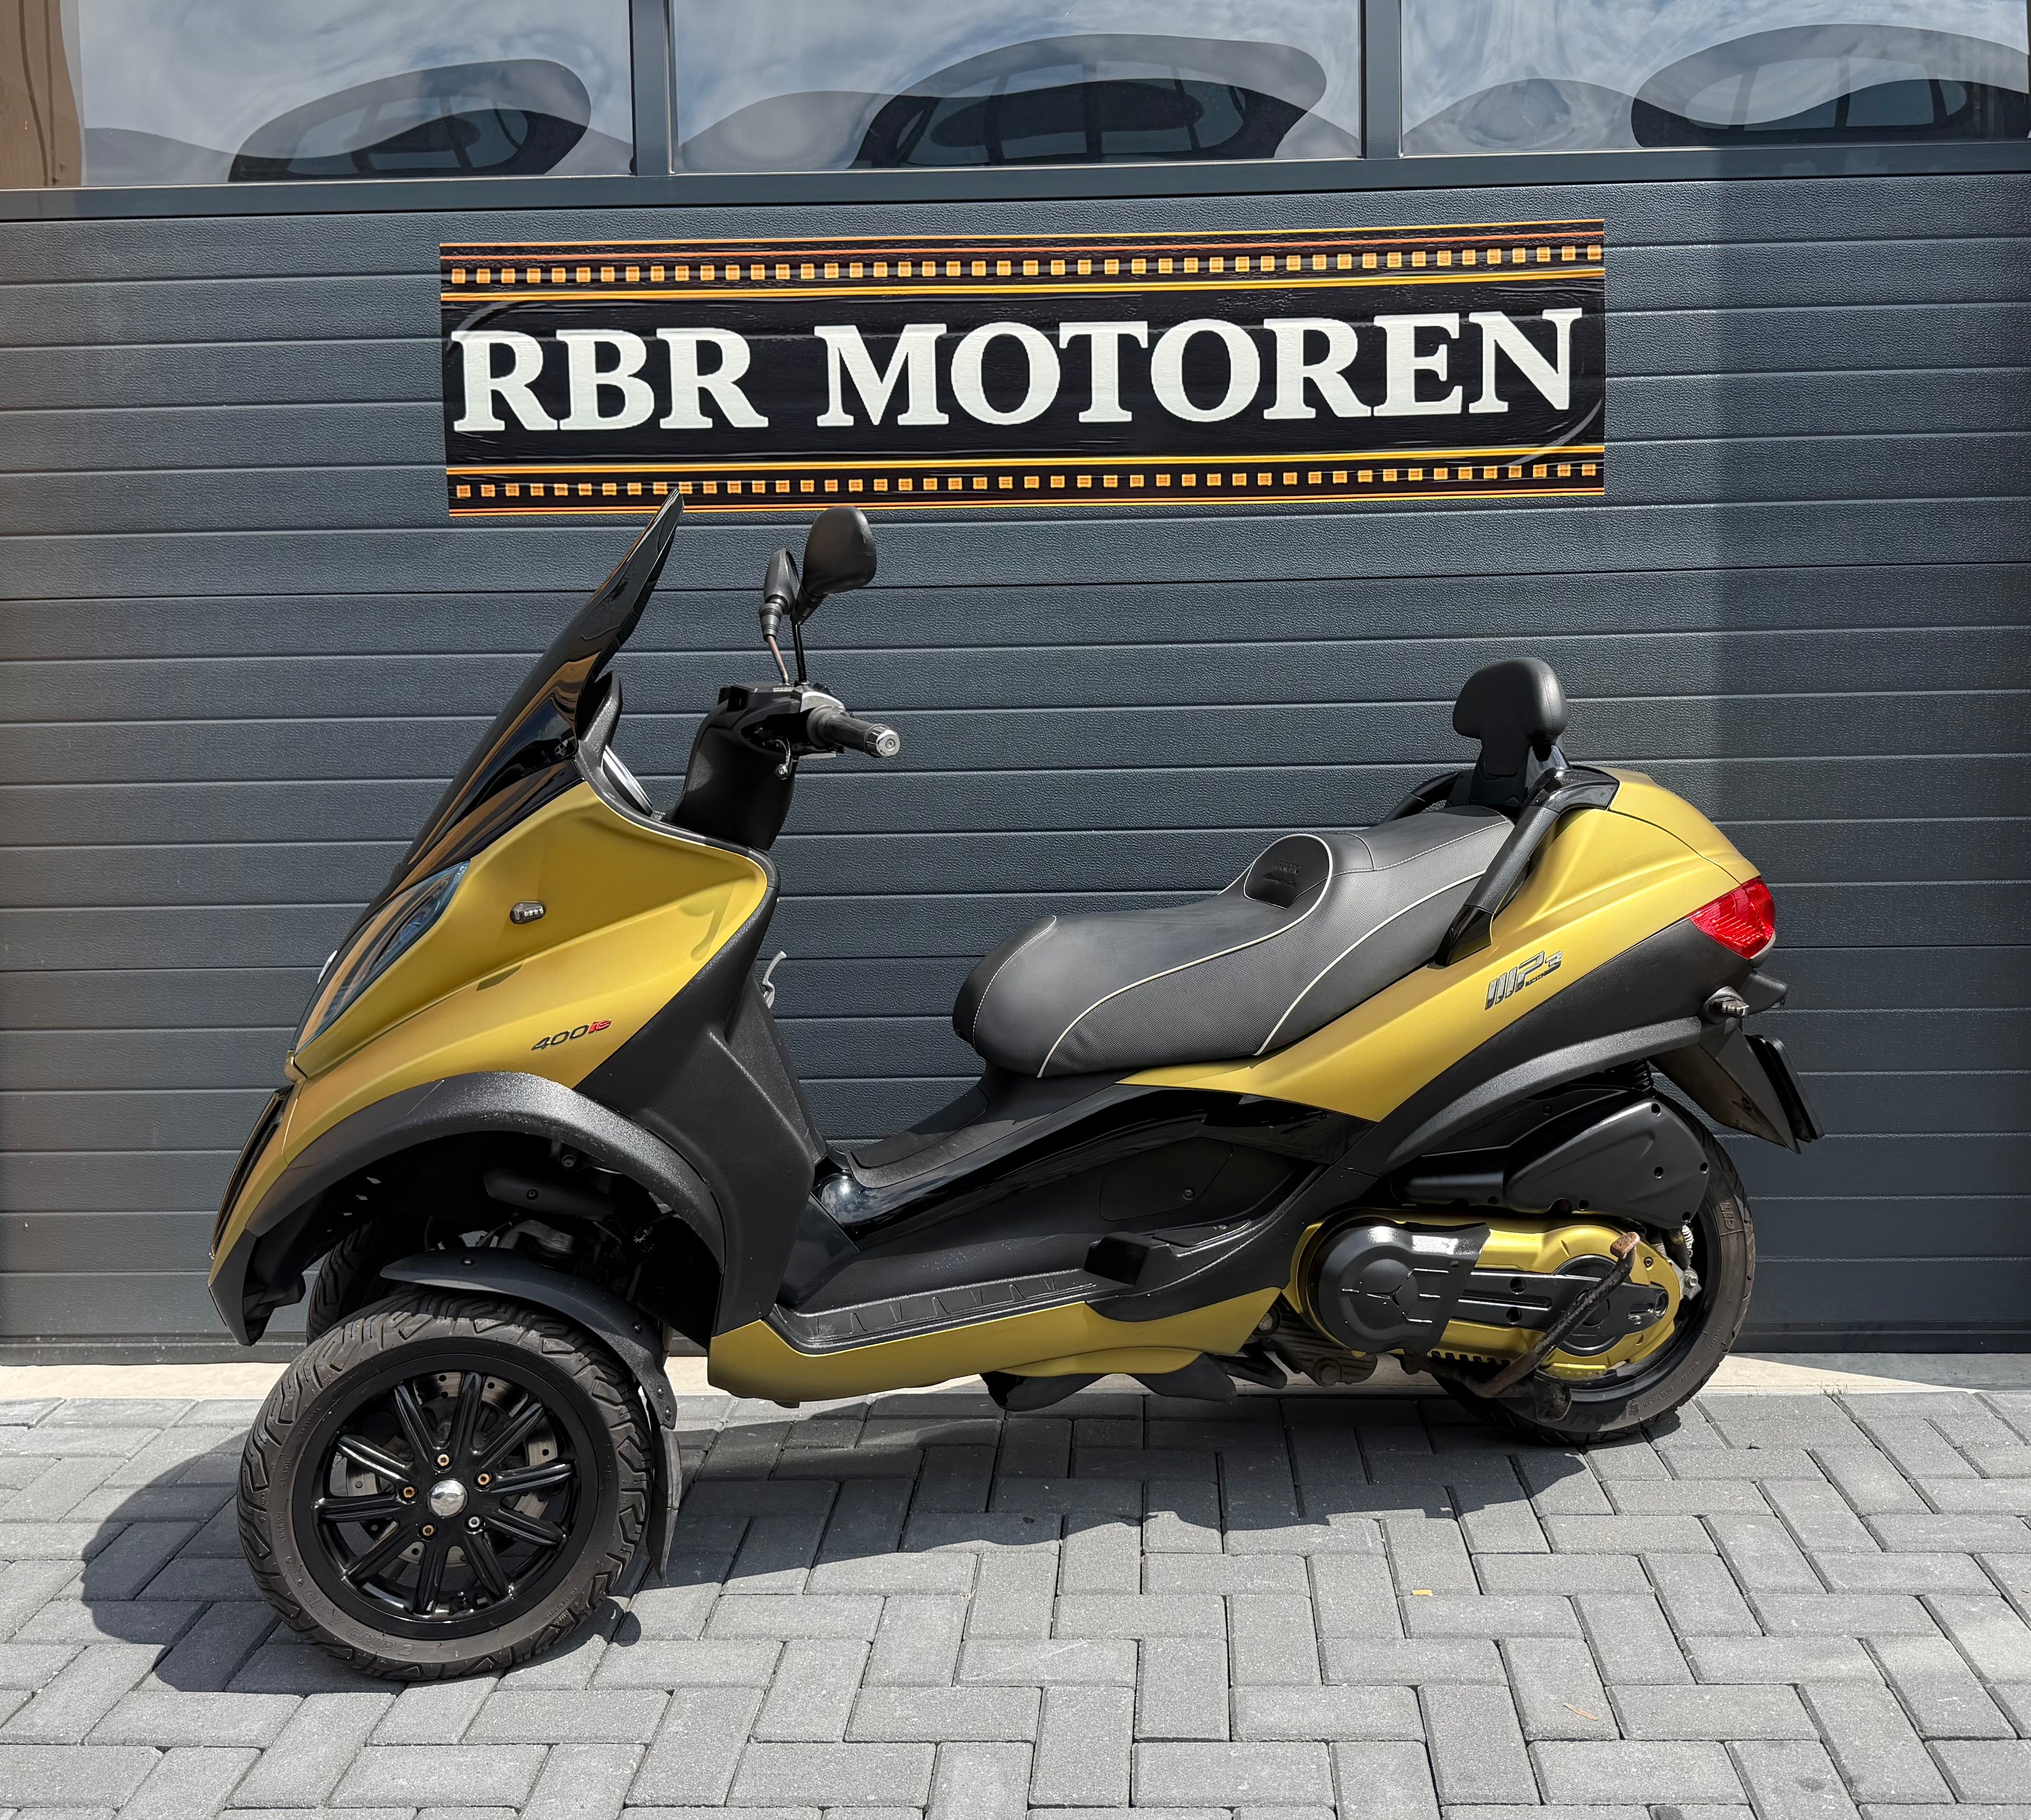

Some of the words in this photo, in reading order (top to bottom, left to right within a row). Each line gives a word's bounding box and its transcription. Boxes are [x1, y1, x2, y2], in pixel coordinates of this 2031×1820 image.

[451, 328, 769, 431] RBR
[815, 308, 1582, 426] MOTOREN
[301, 1588, 347, 1626] CITY
[345, 1625, 396, 1652] GRIP
[397, 1643, 414, 1657] 2
